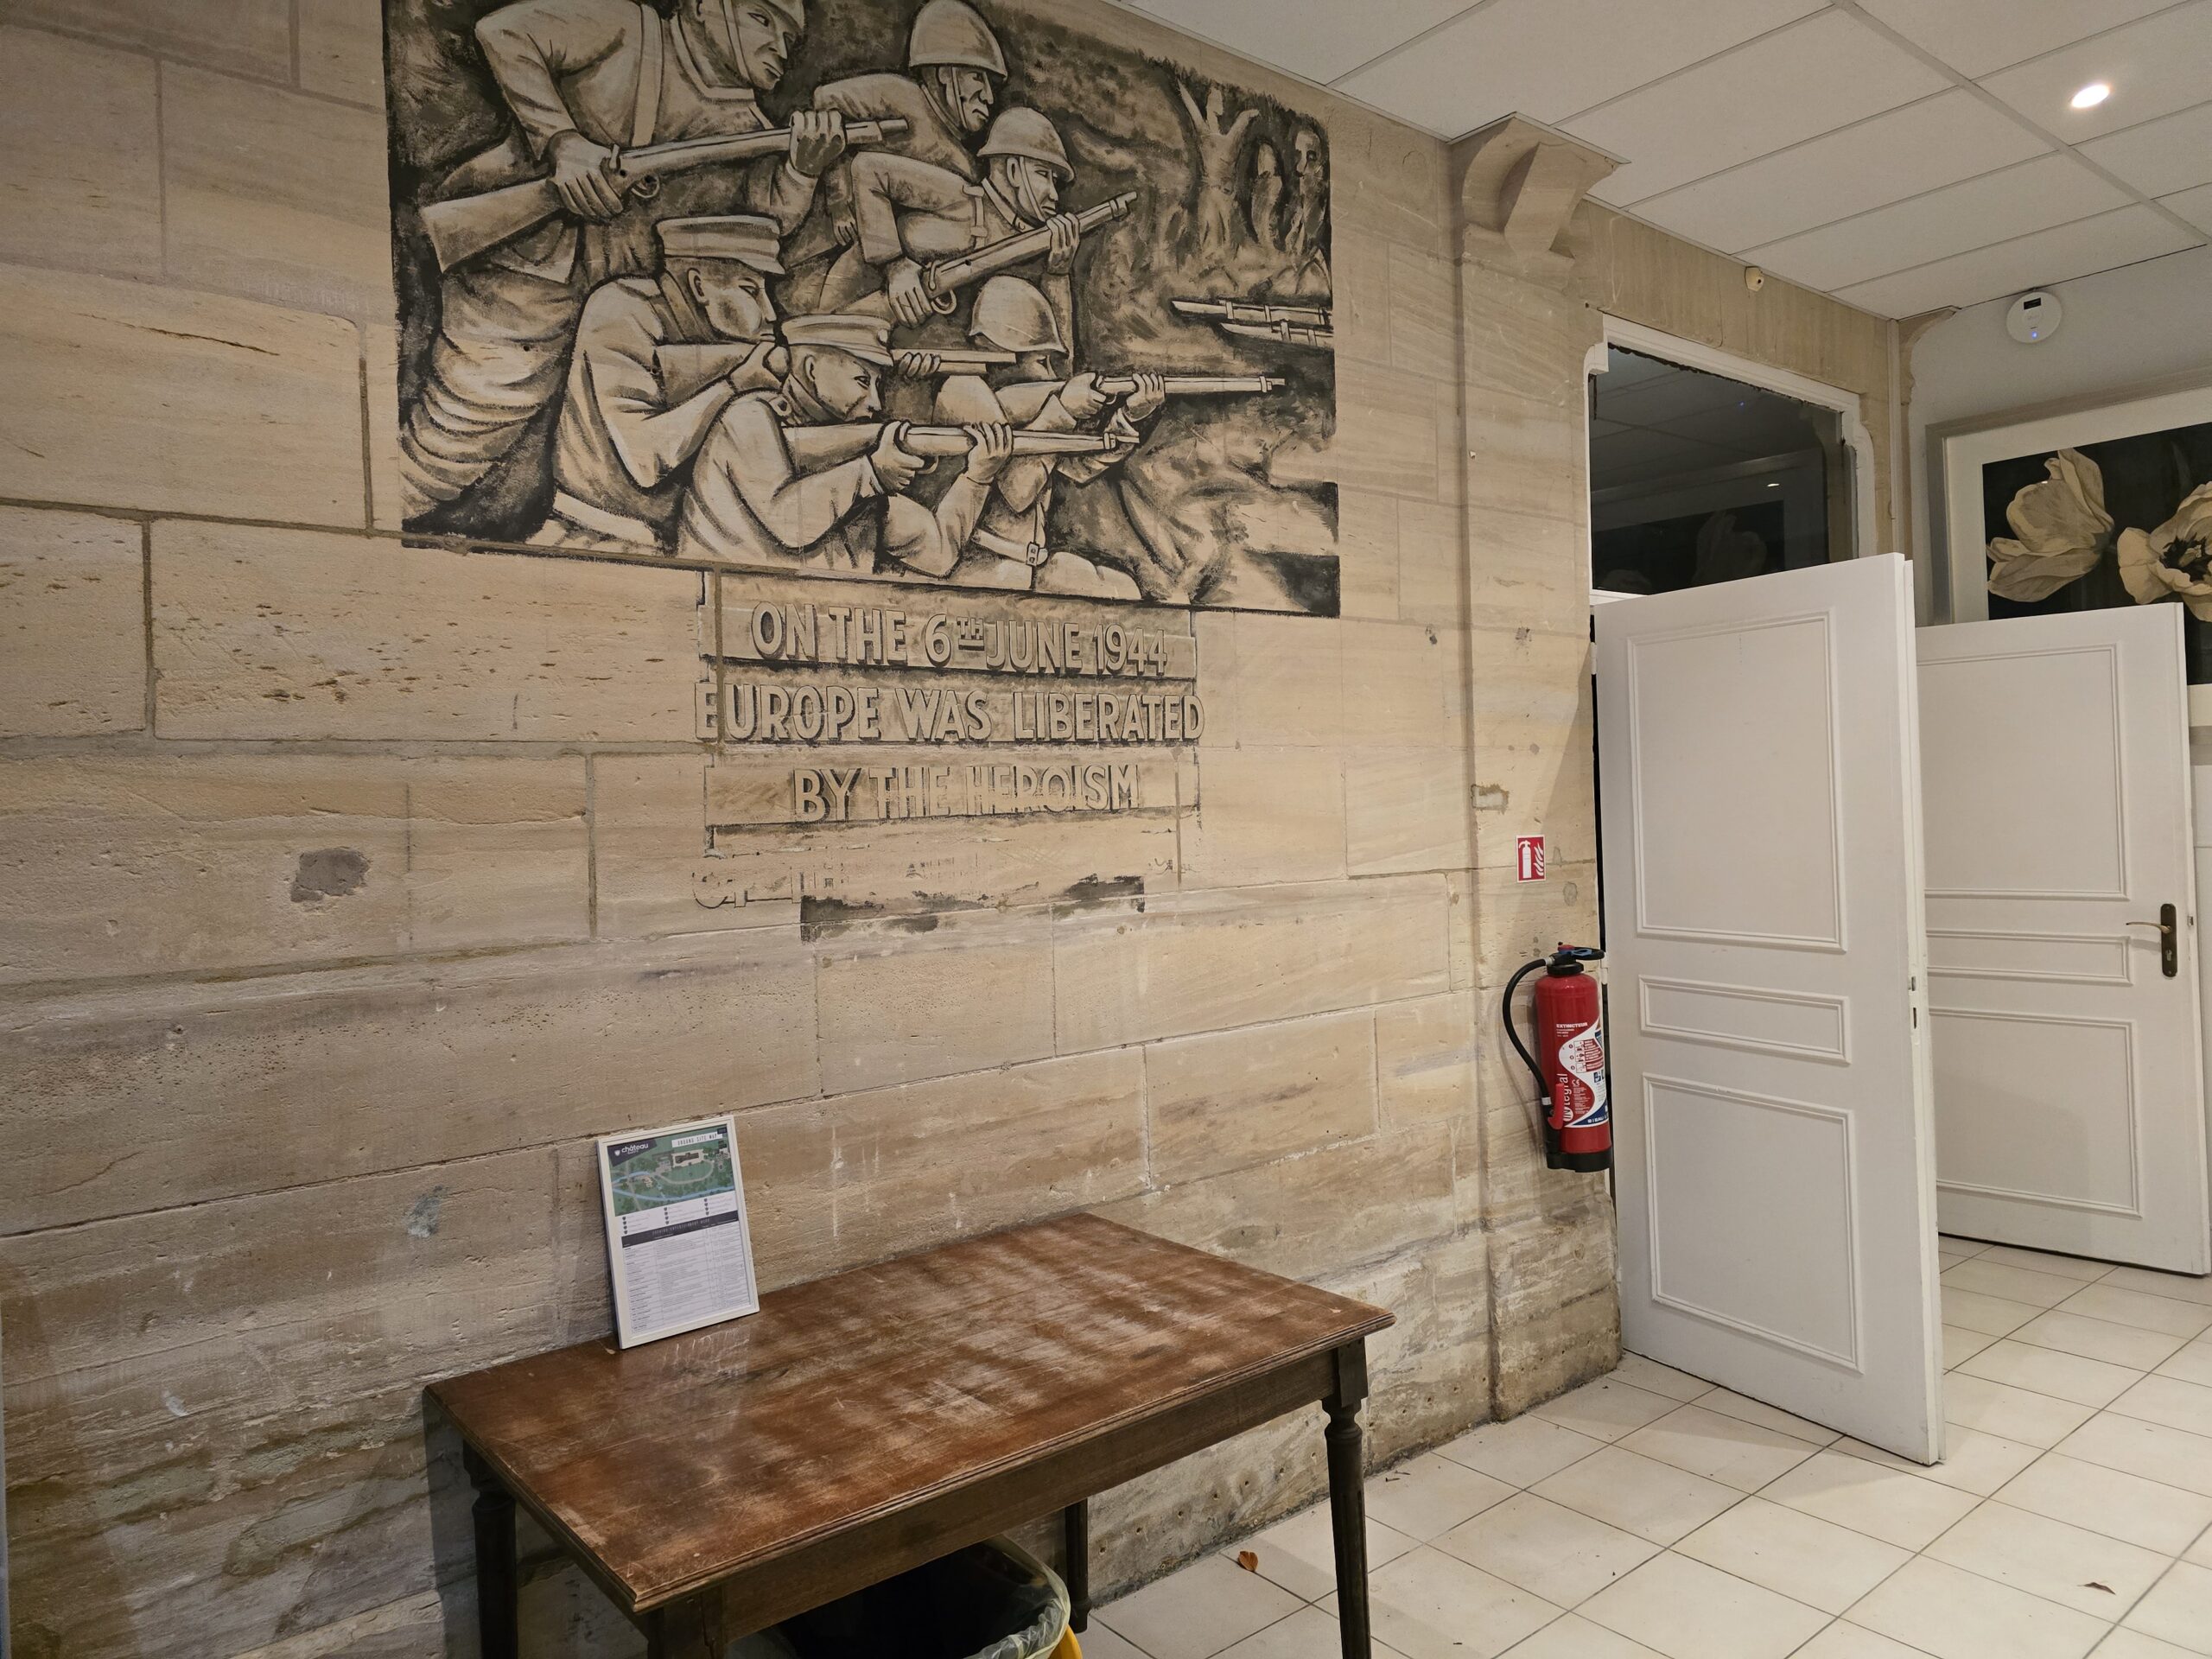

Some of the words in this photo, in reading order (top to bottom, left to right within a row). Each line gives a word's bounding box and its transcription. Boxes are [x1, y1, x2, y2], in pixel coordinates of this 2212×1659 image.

[753, 601, 817, 662] ON
[829, 607, 908, 664] THE
[986, 620, 1083, 675] JUNE
[1093, 623, 1168, 677] 1944
[694, 683, 883, 742] EUROPE
[894, 689, 992, 742] WAS
[1013, 691, 1205, 742] LIBERATED
[793, 766, 863, 823] BY
[869, 766, 950, 819] THE
[965, 764, 1141, 817] HEROISM
